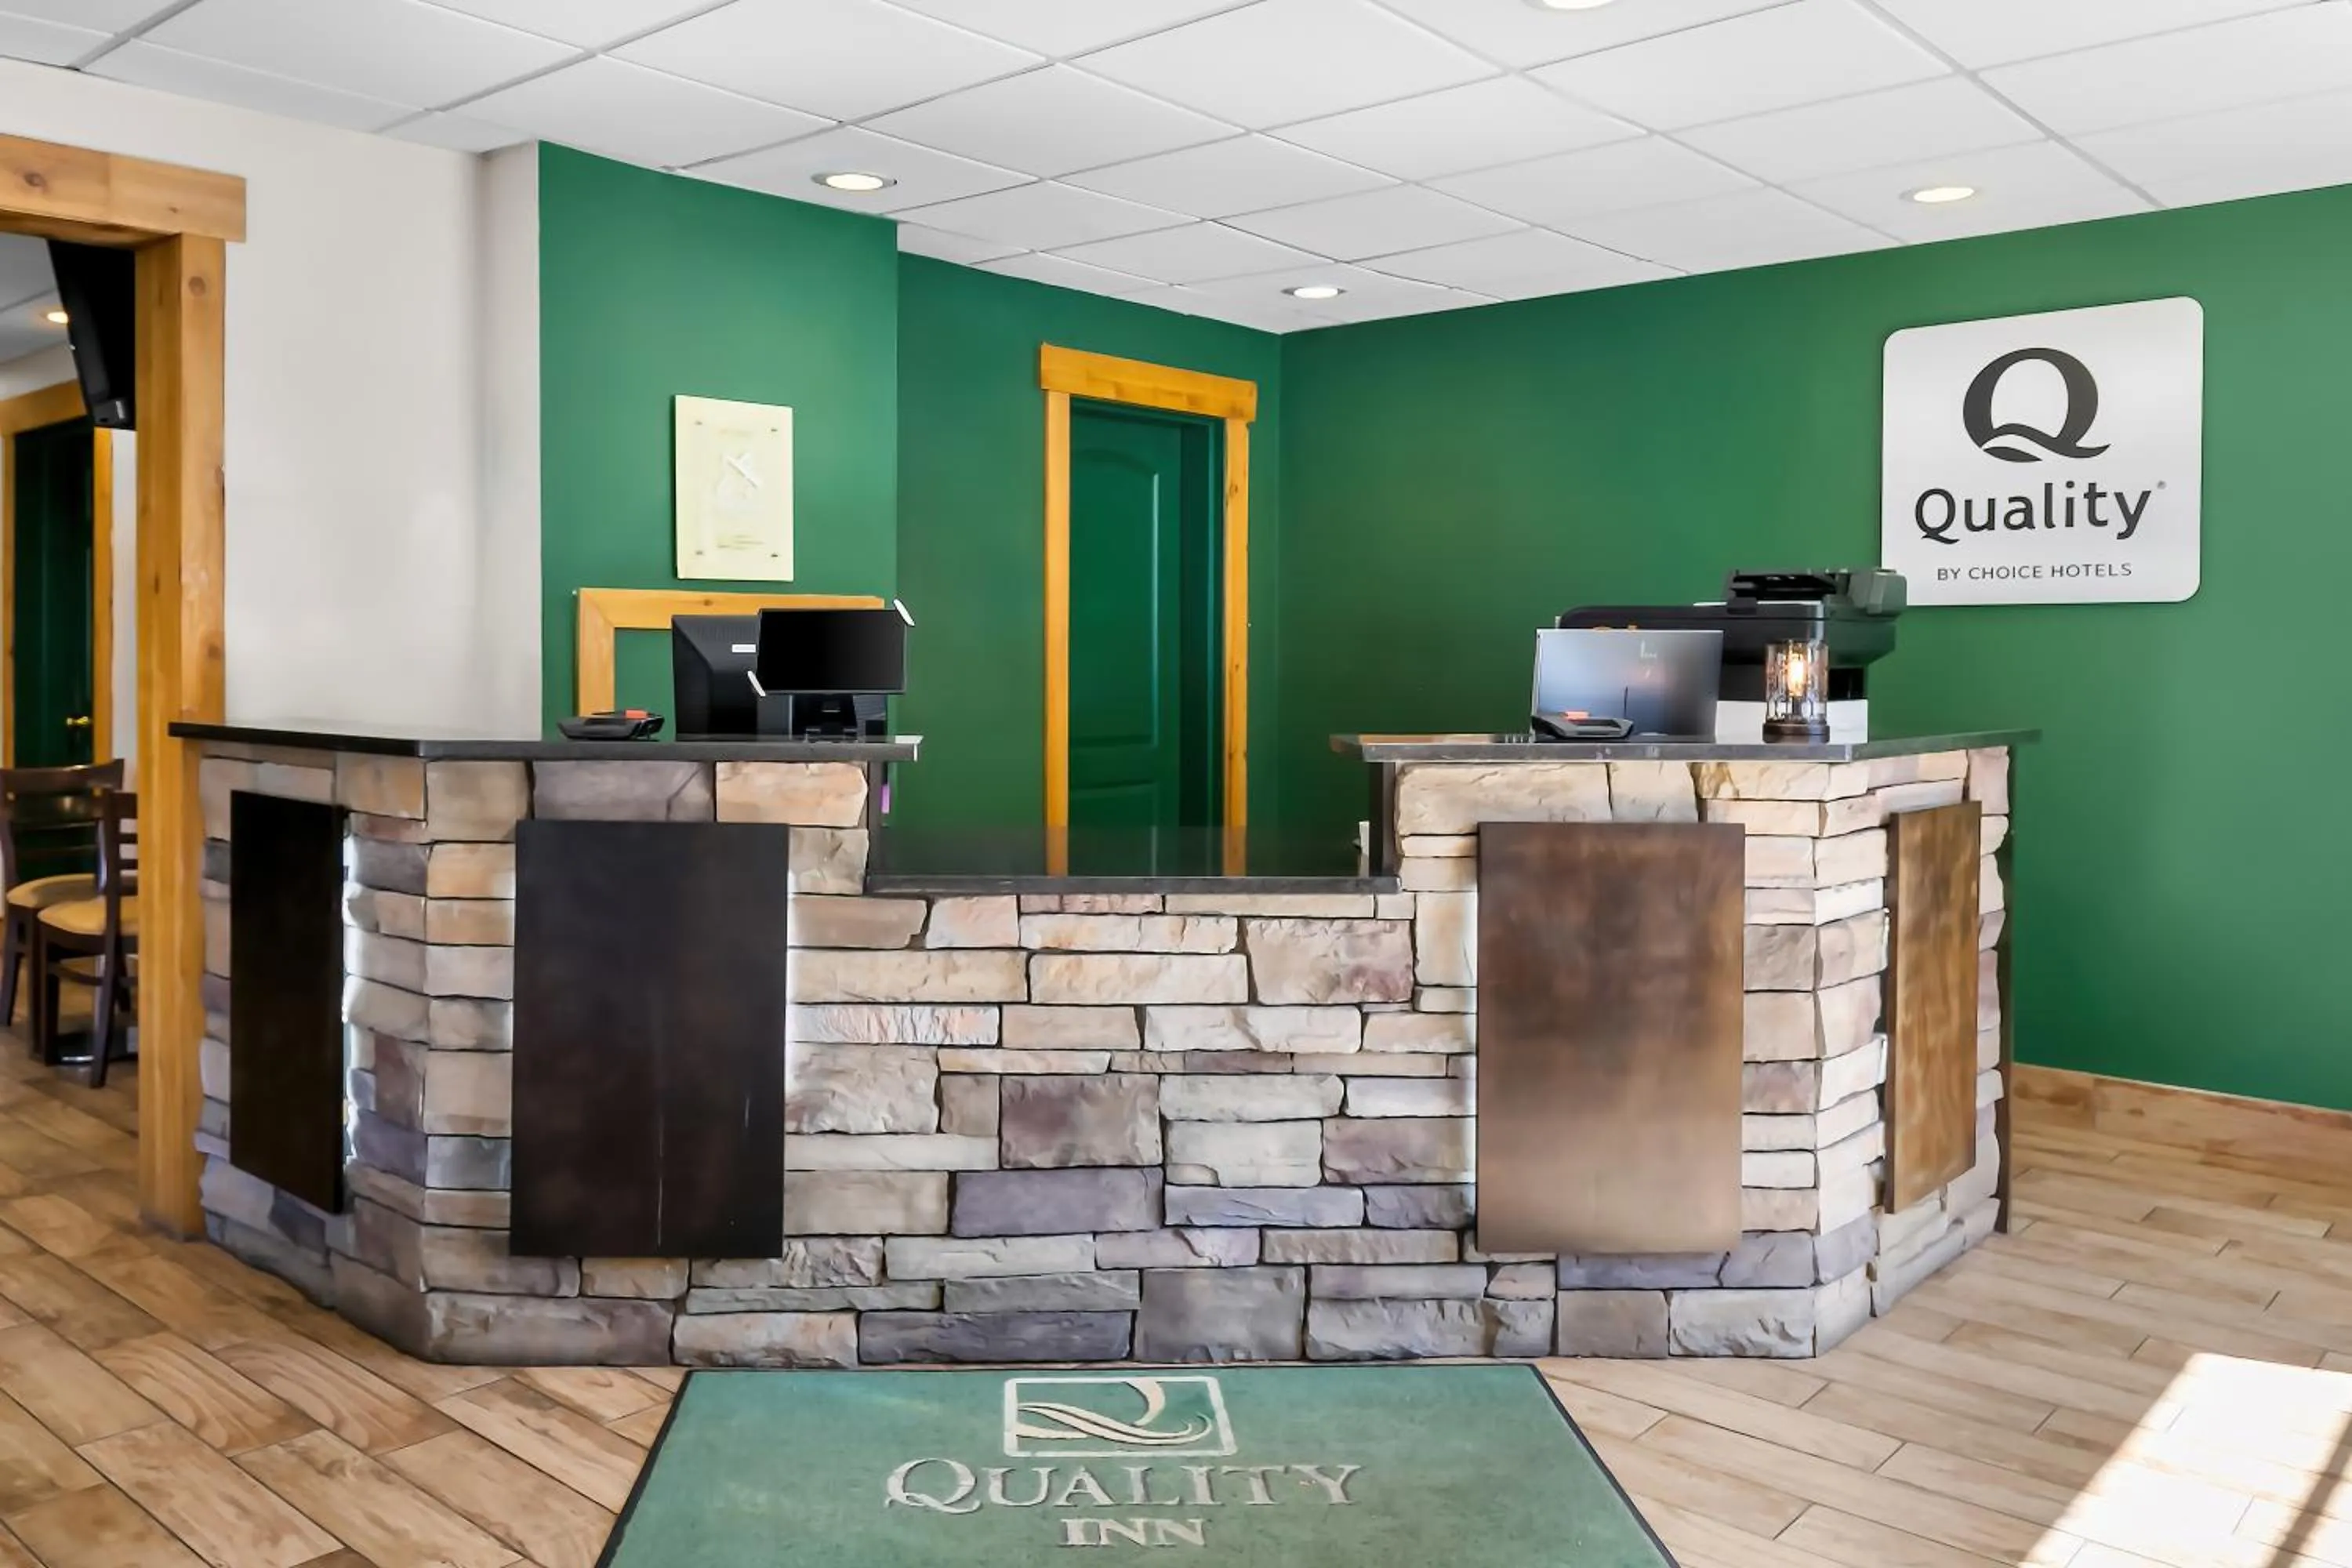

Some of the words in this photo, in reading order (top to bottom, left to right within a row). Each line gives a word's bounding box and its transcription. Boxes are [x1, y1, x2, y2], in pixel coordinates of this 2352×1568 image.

[1915, 480, 2152, 545] Quality
[1937, 567, 1961, 581] BY
[1968, 565, 2042, 580] CHOICE
[2050, 563, 2132, 578] HOTELS
[884, 1457, 1361, 1514] QUALITY
[1058, 1517, 1206, 1547] INN
